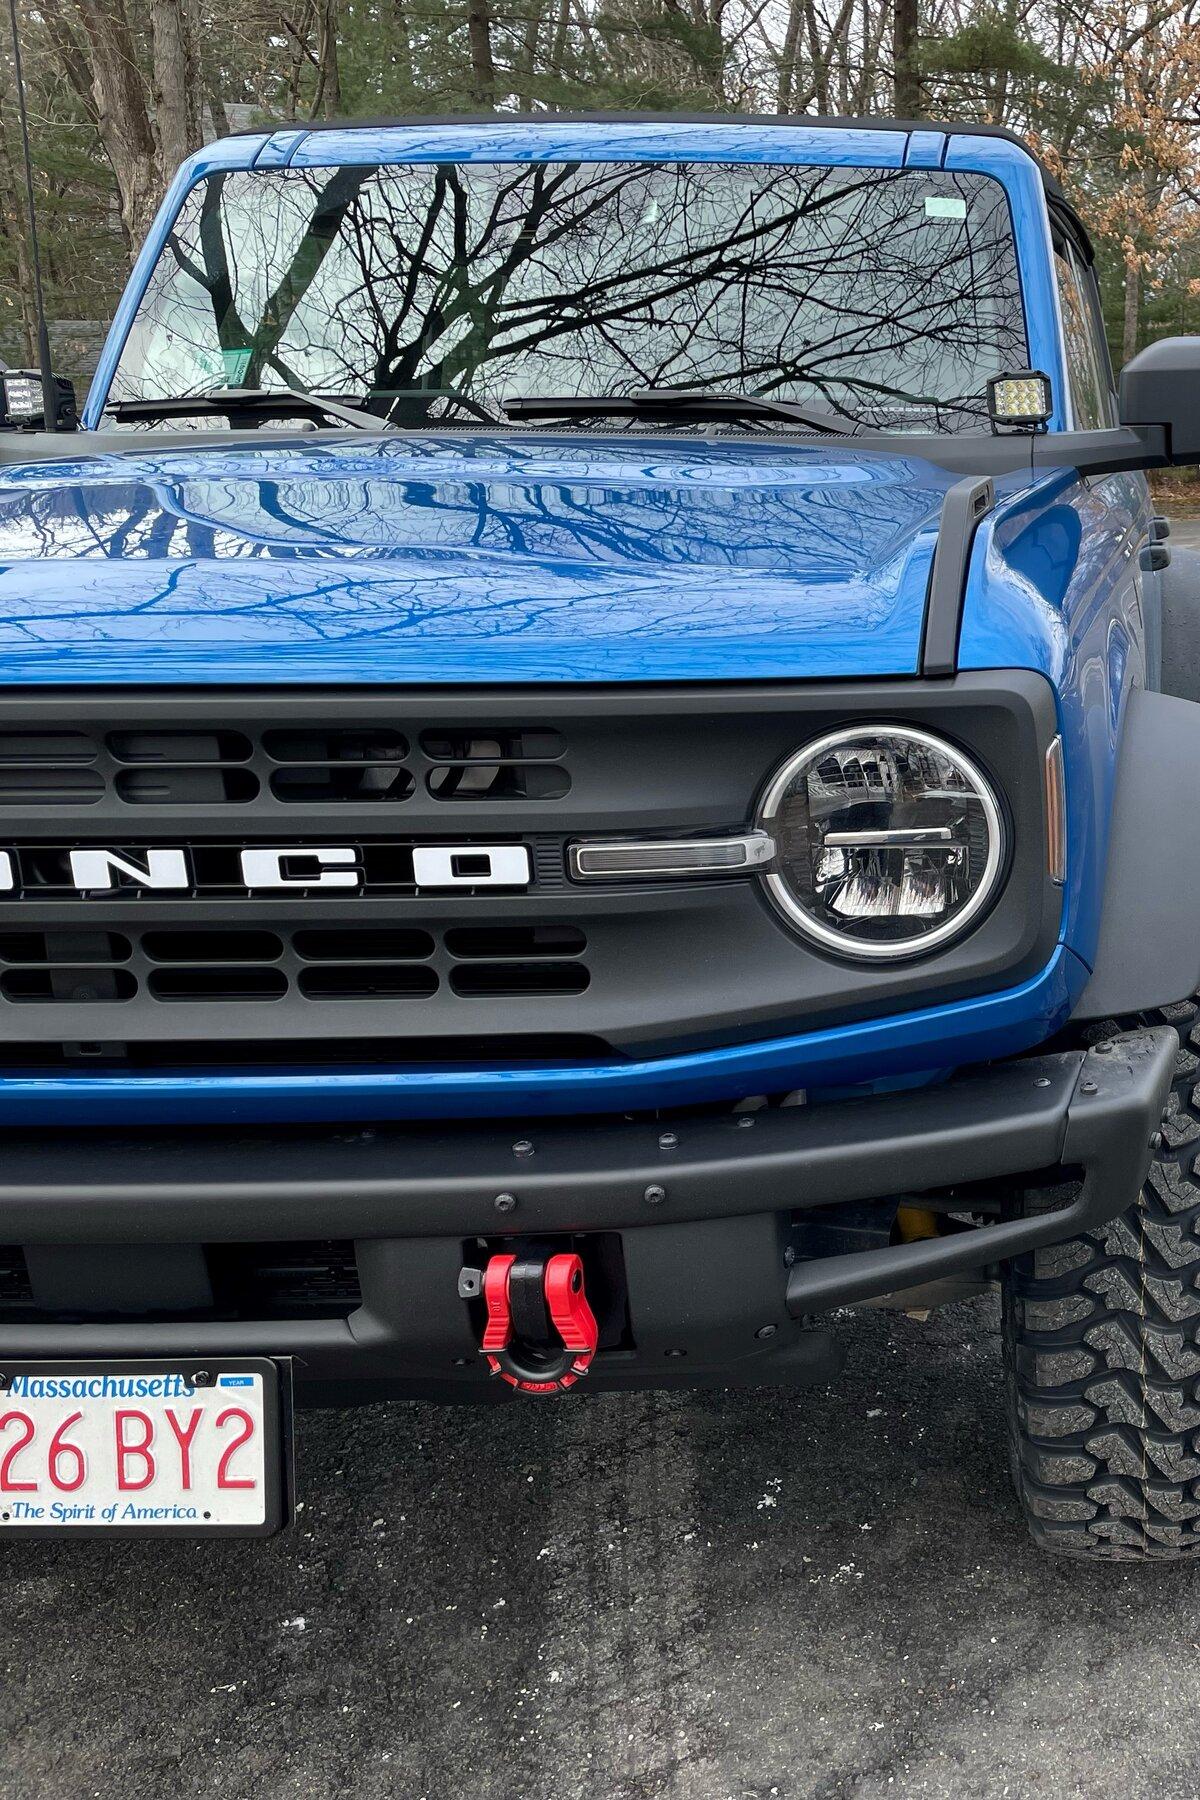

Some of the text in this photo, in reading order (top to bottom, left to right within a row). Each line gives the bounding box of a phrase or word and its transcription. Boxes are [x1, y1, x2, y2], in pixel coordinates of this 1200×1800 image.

[0, 846, 530, 890] NCO
[0, 1408, 256, 1492] 26 BY2
[12, 1502, 197, 1522] The Spirit of America
